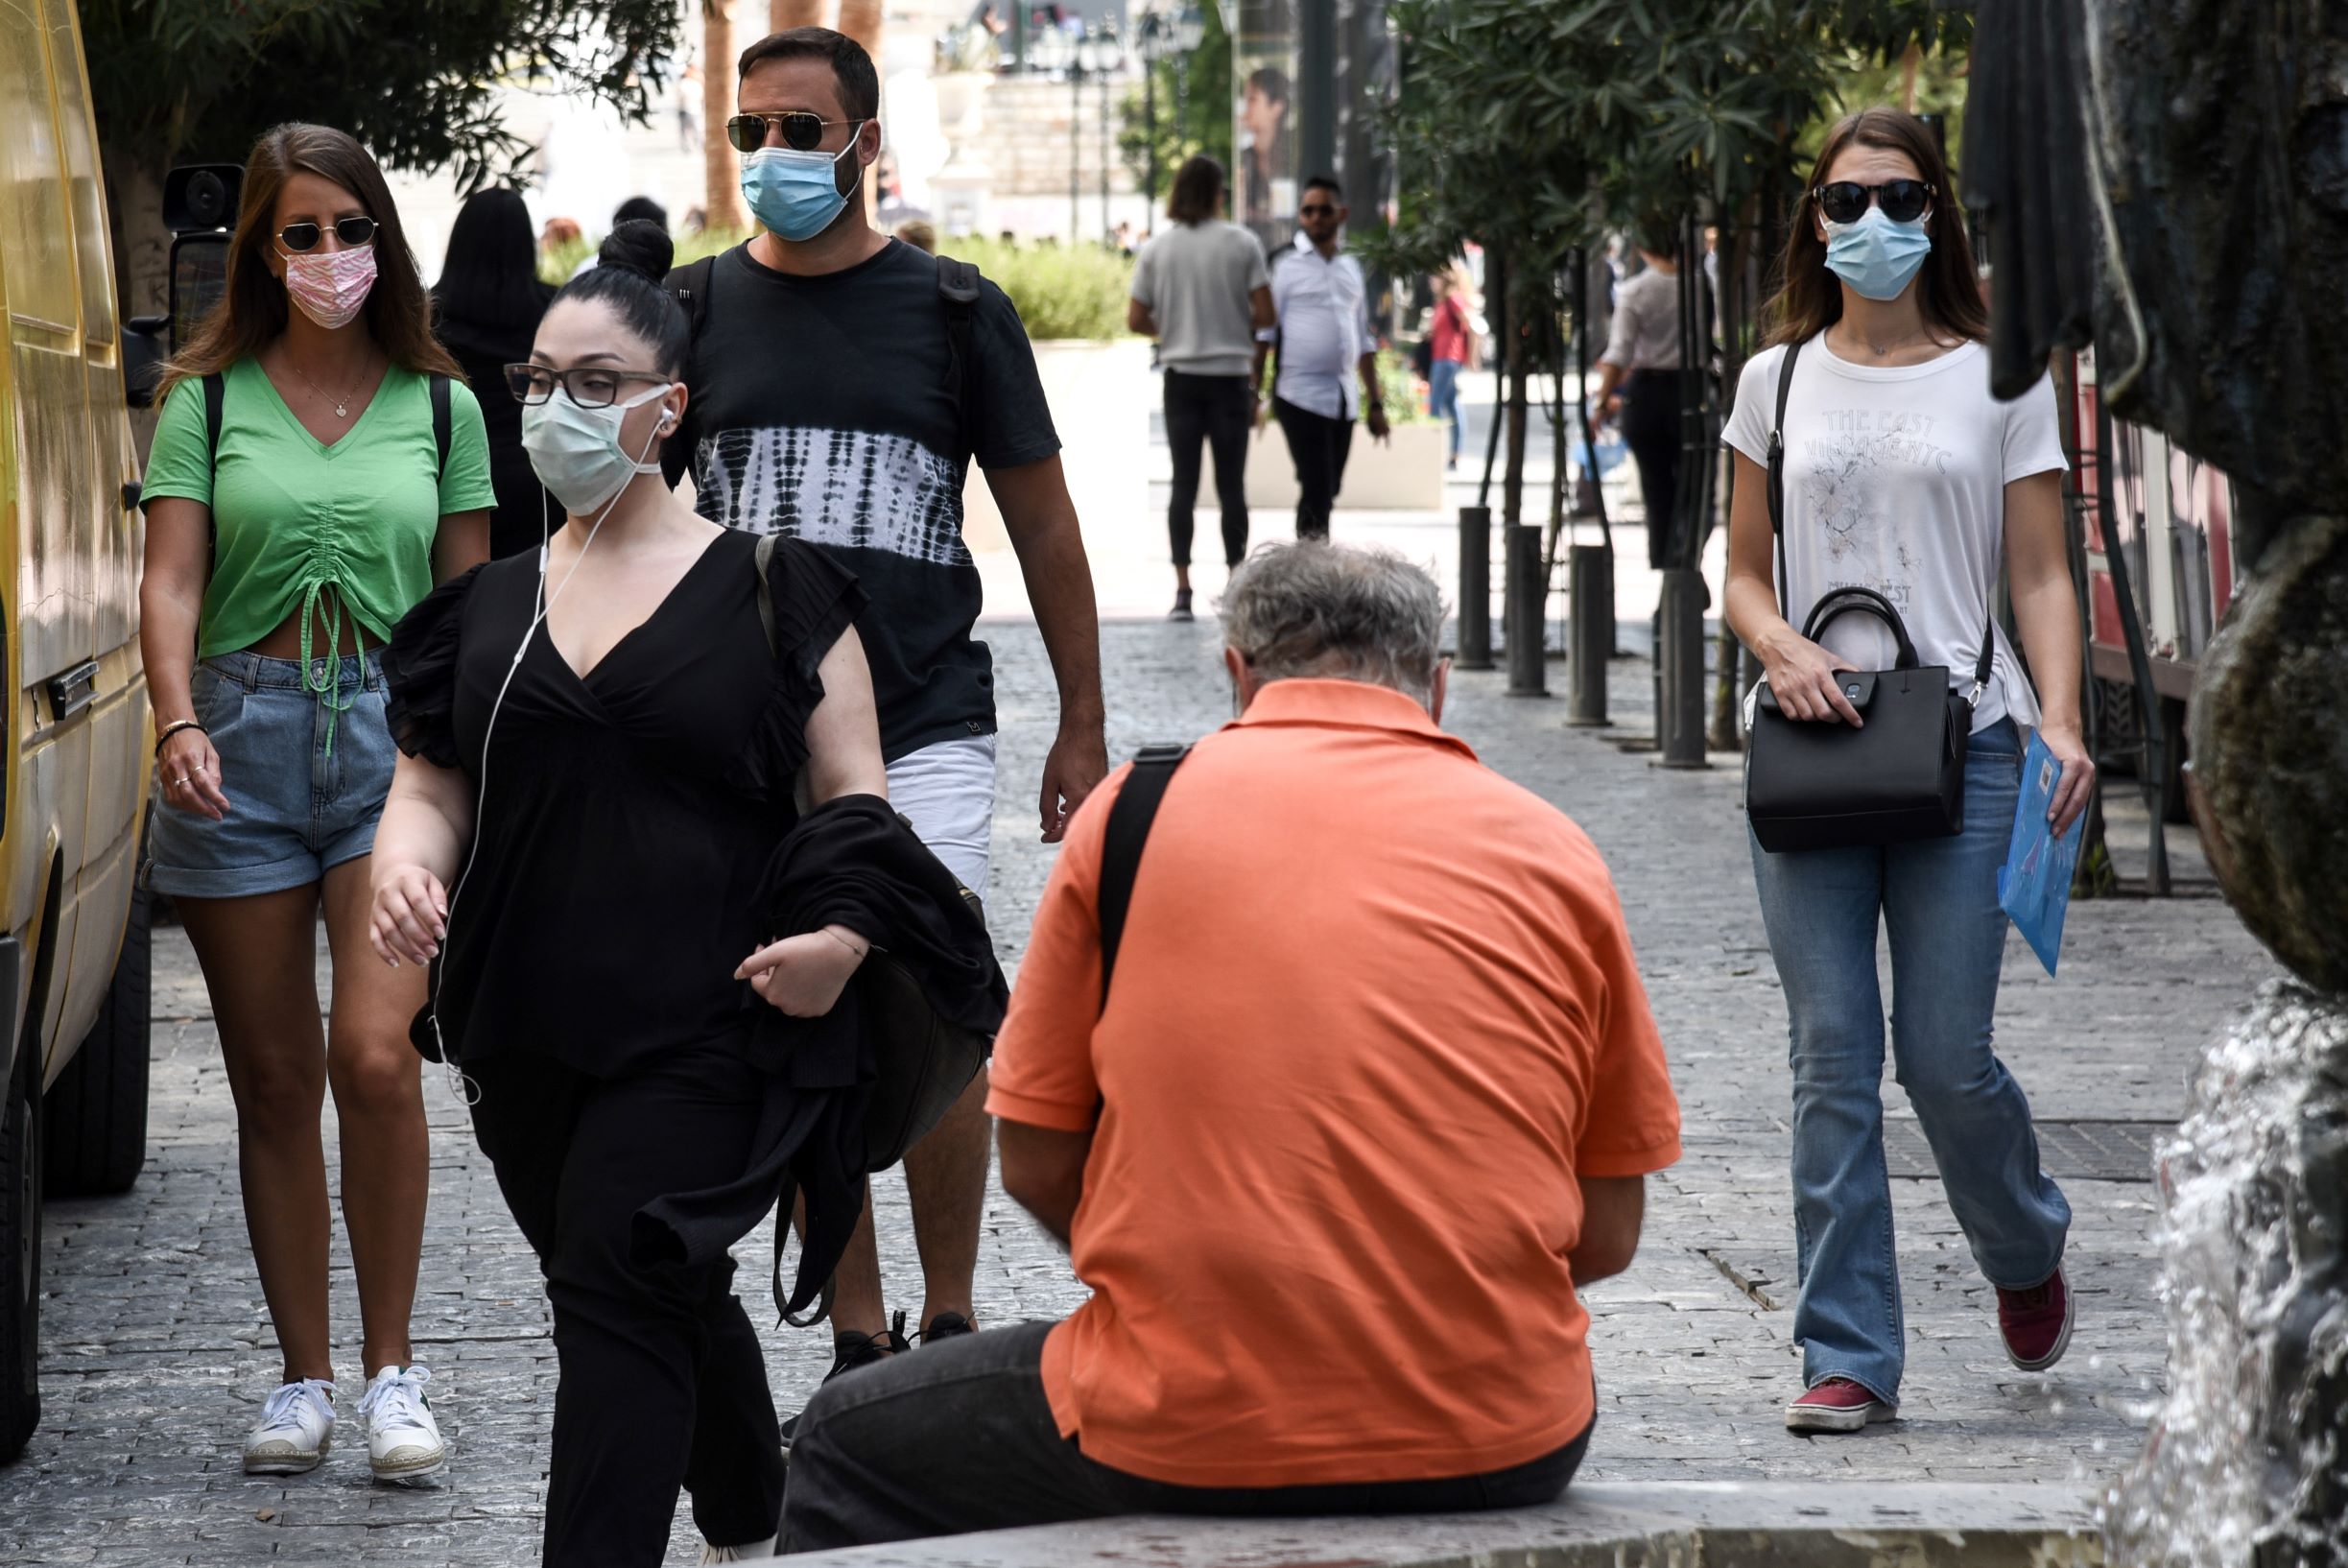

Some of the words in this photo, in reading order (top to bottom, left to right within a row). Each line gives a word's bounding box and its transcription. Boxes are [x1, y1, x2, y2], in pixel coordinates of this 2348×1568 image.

[1821, 410, 1870, 430] THE
[1878, 409, 1935, 438] EAST
[1804, 436, 1899, 463] VILLAGE
[1902, 440, 1952, 475] NYC
